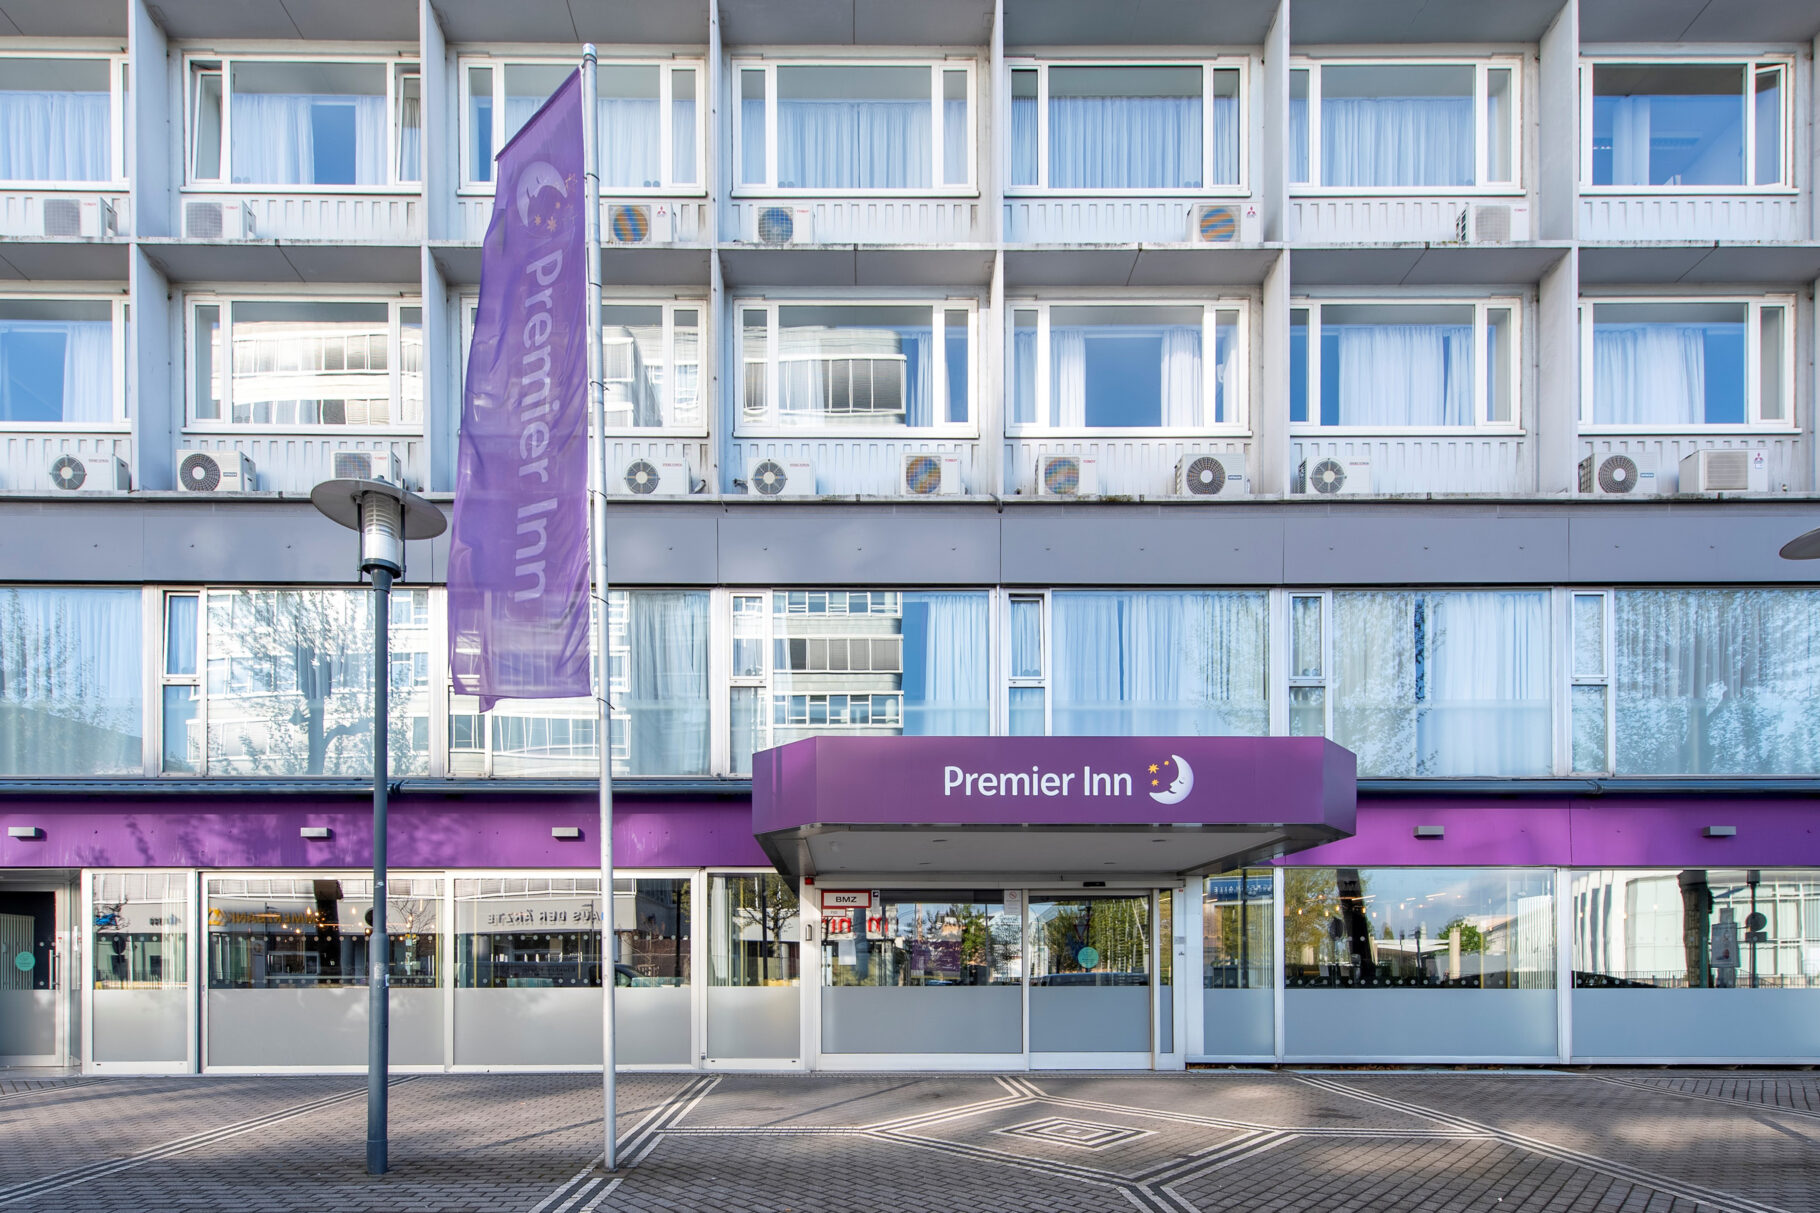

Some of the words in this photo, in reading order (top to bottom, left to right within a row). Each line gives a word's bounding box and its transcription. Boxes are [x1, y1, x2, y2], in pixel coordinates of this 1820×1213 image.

[517, 249, 564, 482] Premier
[514, 497, 558, 602] Inn
[944, 765, 1075, 796] Premier
[1084, 766, 1132, 796] Inn
